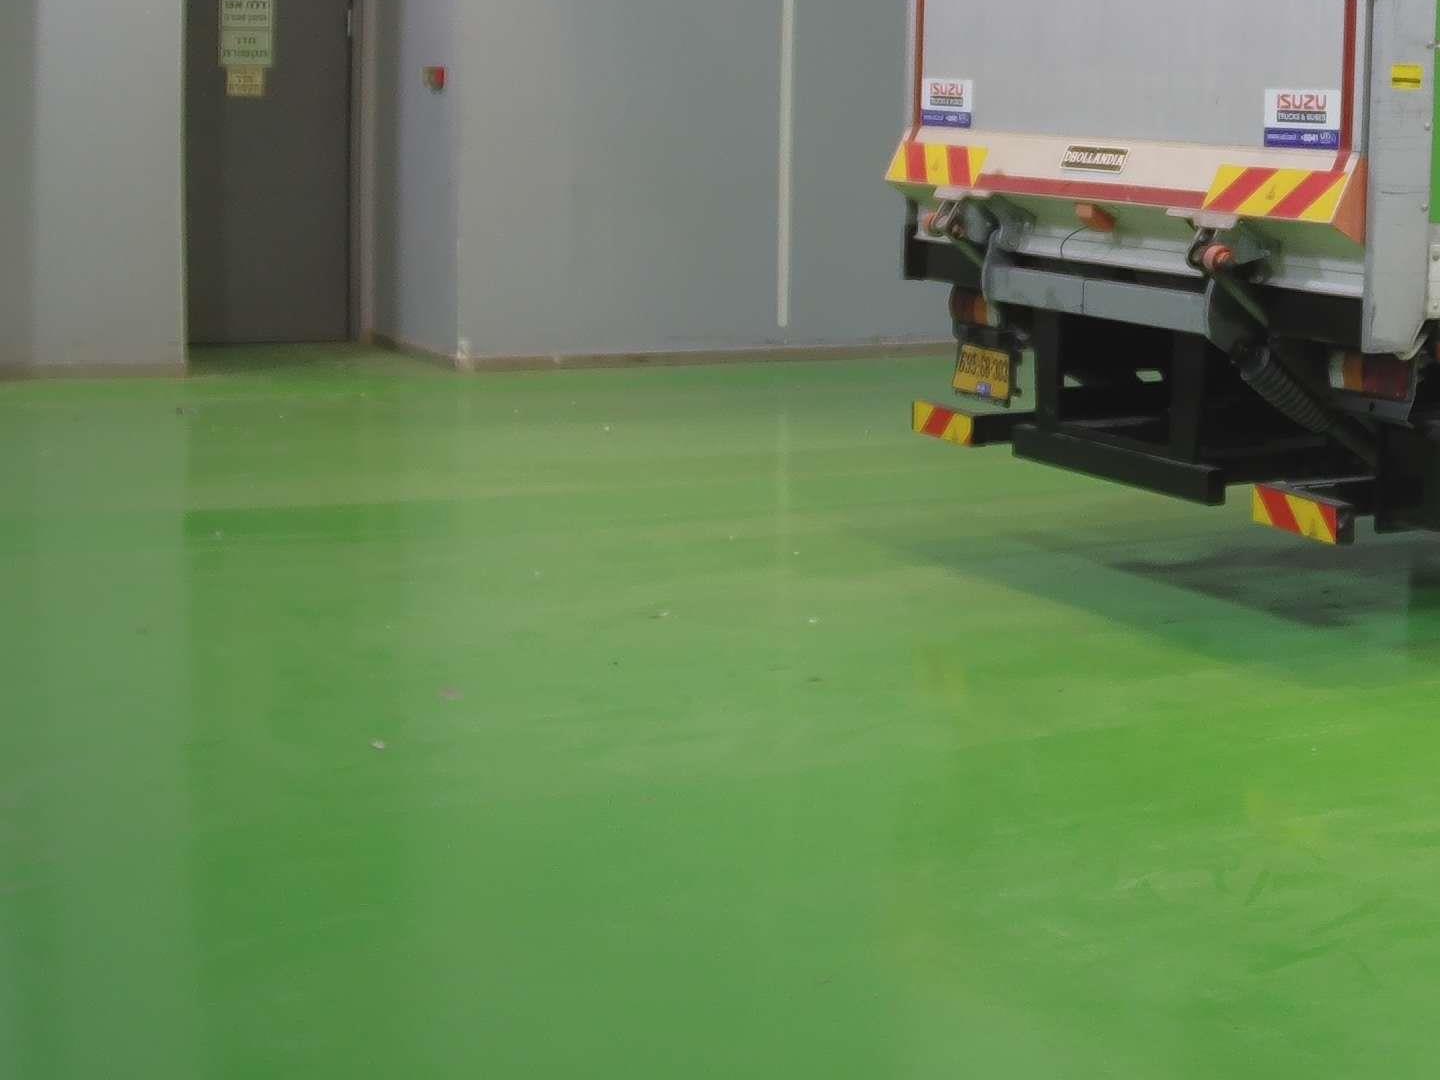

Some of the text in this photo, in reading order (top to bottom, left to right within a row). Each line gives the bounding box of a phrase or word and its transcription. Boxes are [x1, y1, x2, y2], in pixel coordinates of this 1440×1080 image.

[930, 82, 963, 96] ISUZU
[1277, 94, 1327, 110] ISUZU
[1064, 151, 1124, 166] DHOLLANDIA
